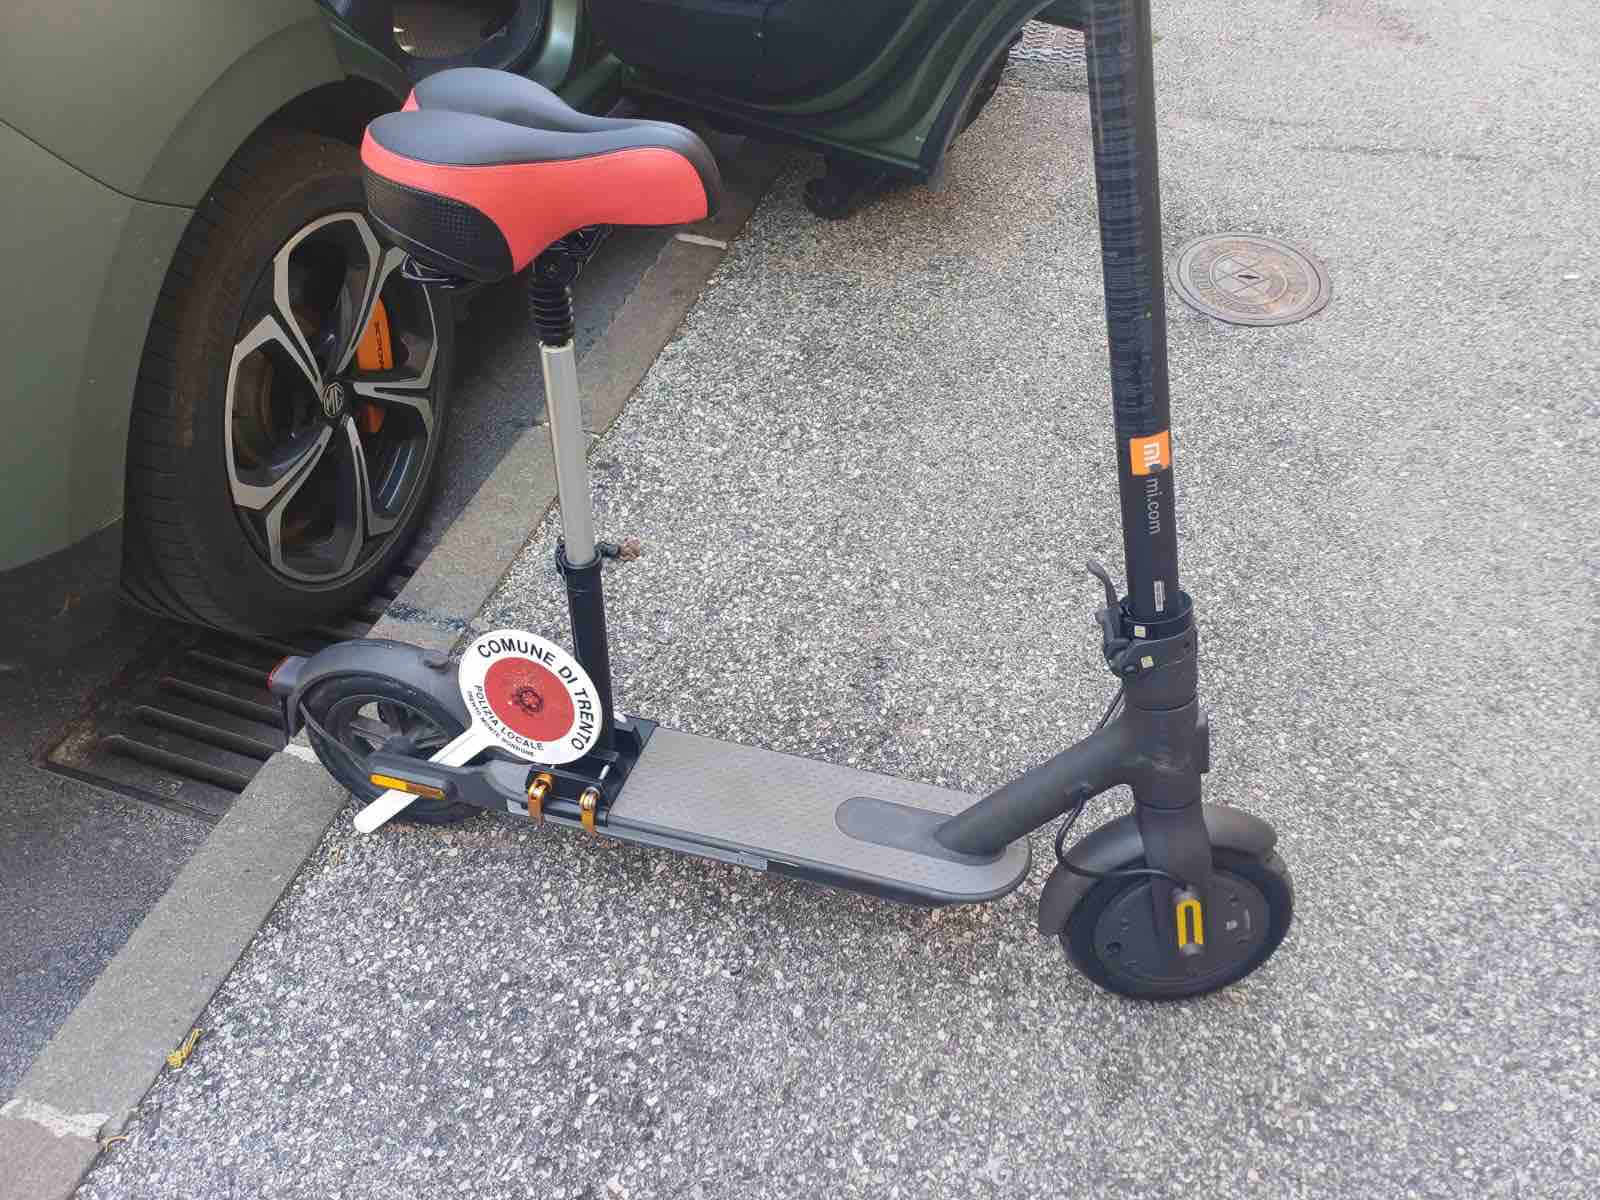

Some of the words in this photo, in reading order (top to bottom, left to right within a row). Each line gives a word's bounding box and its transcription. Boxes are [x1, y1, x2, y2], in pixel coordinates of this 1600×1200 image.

[321, 384, 344, 416] MG
[1145, 478, 1162, 534] mi.com
[473, 684, 499, 727] POLIZIA
[500, 726, 545, 752] LOCALE
[478, 638, 556, 666] COMUNE
[558, 665, 578, 684] DI
[571, 688, 594, 750] TRENTO
